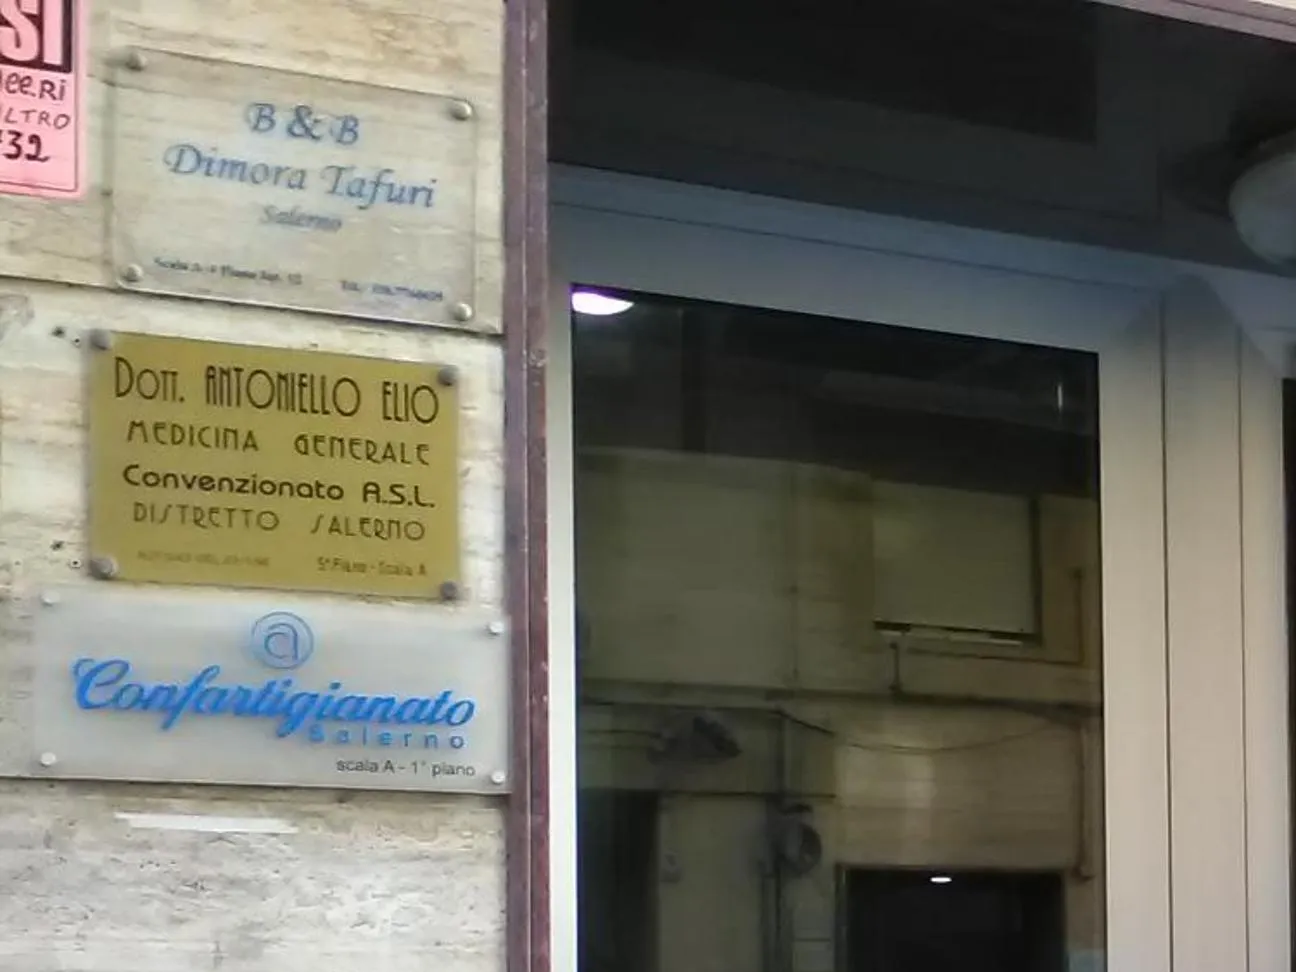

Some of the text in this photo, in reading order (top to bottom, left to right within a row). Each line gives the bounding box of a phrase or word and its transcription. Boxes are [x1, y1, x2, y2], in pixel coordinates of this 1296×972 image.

[0, 106, 70, 130] LTRO
[248, 102, 360, 146] B & B
[163, 142, 437, 211] Dimora Tafuri
[204, 364, 361, 418] ANTONIELLO
[382, 380, 440, 425] ELIO
[126, 419, 430, 466] MEDICINA GENERALE
[122, 463, 436, 508] Convenzionato A.S.L.
[133, 502, 426, 541] DISTRETTO SALERNO
[72, 657, 476, 739] Confartigianato
[308, 723, 465, 750] Salerno
[336, 758, 379, 773] scala
[383, 759, 396, 773] A
[431, 761, 477, 778] piano
